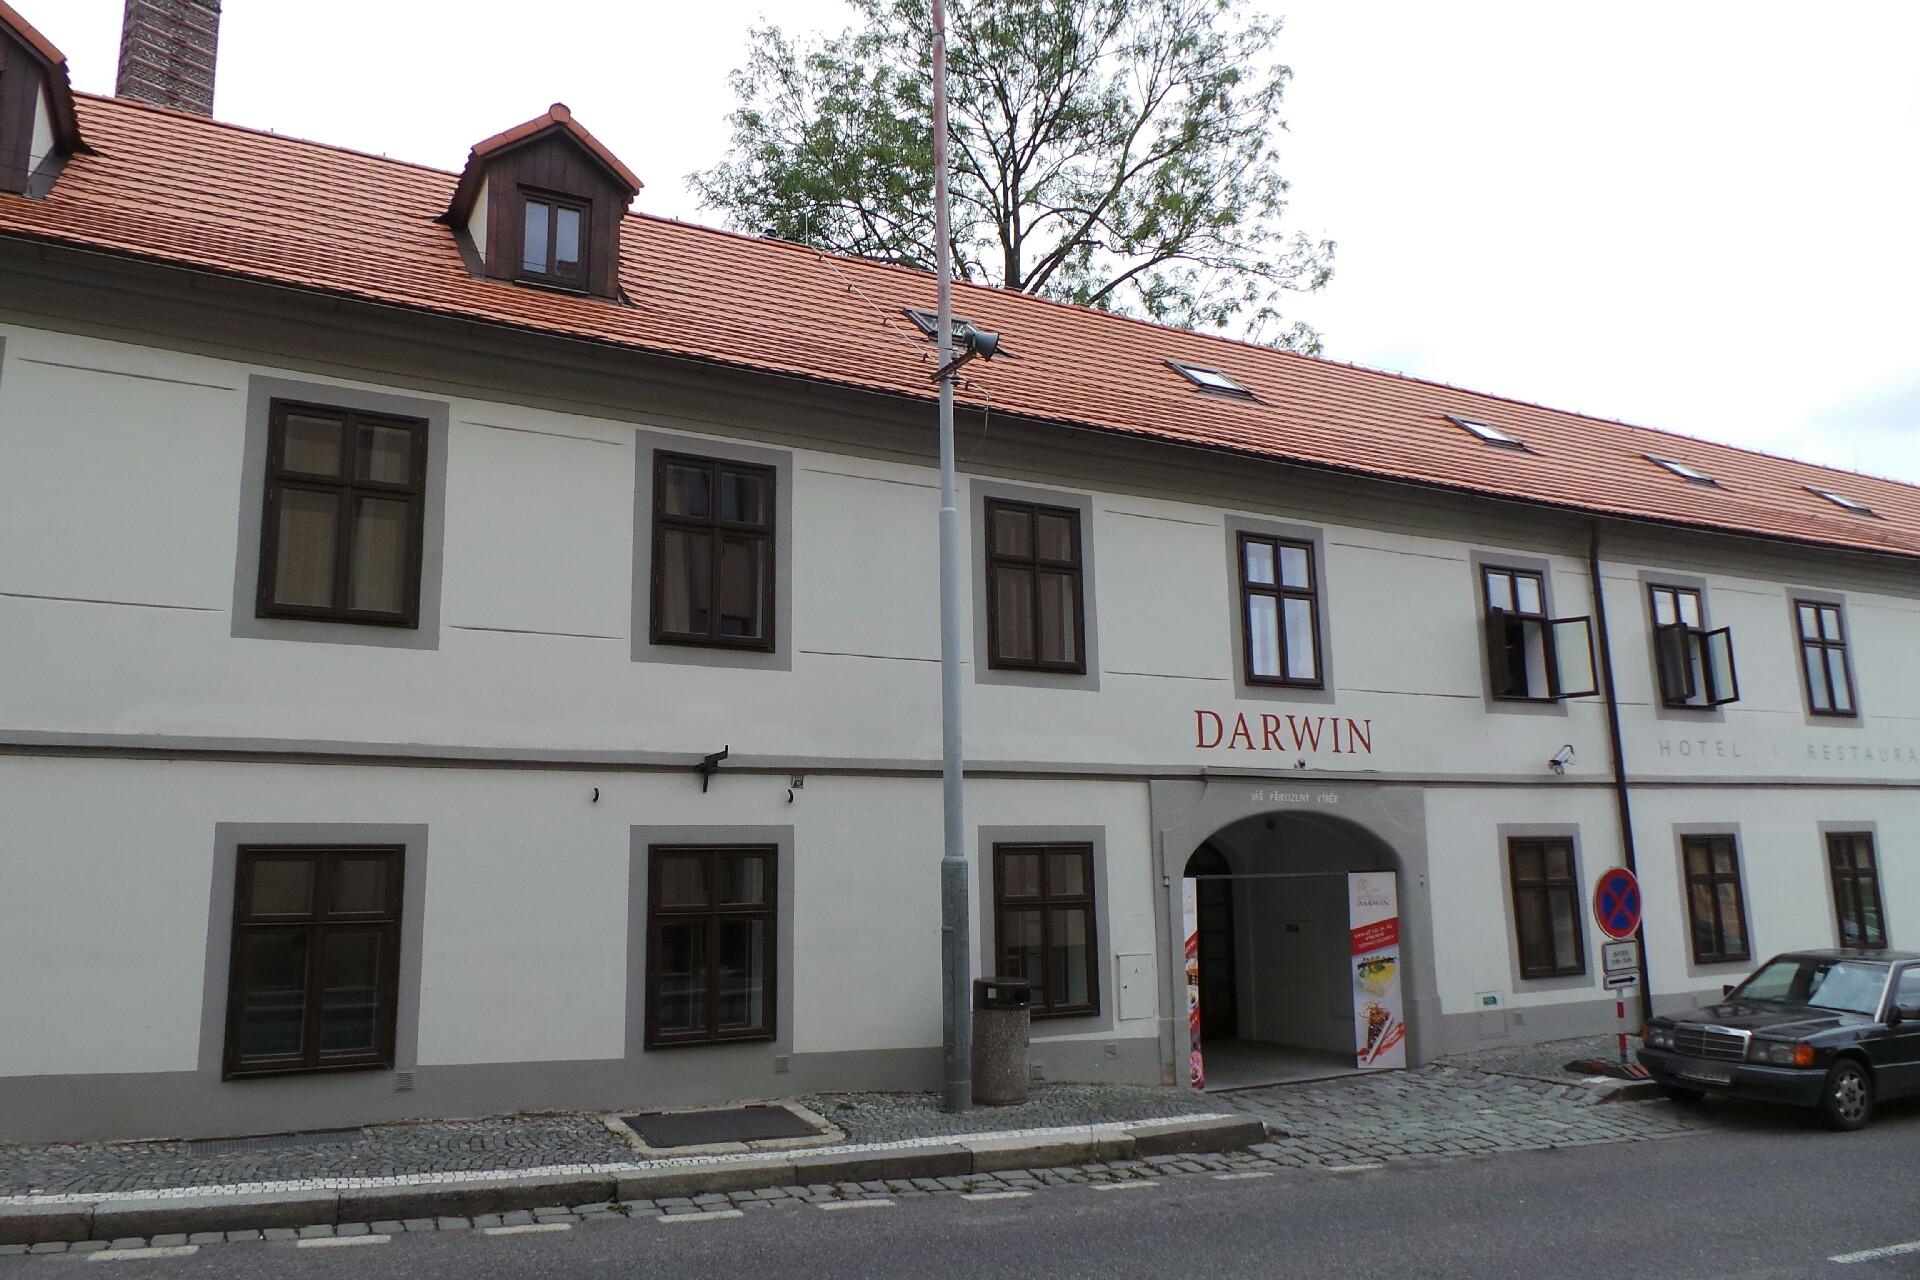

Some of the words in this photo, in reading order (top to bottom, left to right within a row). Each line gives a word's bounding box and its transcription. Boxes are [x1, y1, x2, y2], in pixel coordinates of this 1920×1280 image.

[1194, 710, 1372, 754] DARWIN
[1658, 739, 1742, 757] HOTEL
[1807, 744, 1919, 762] RESTAURA
